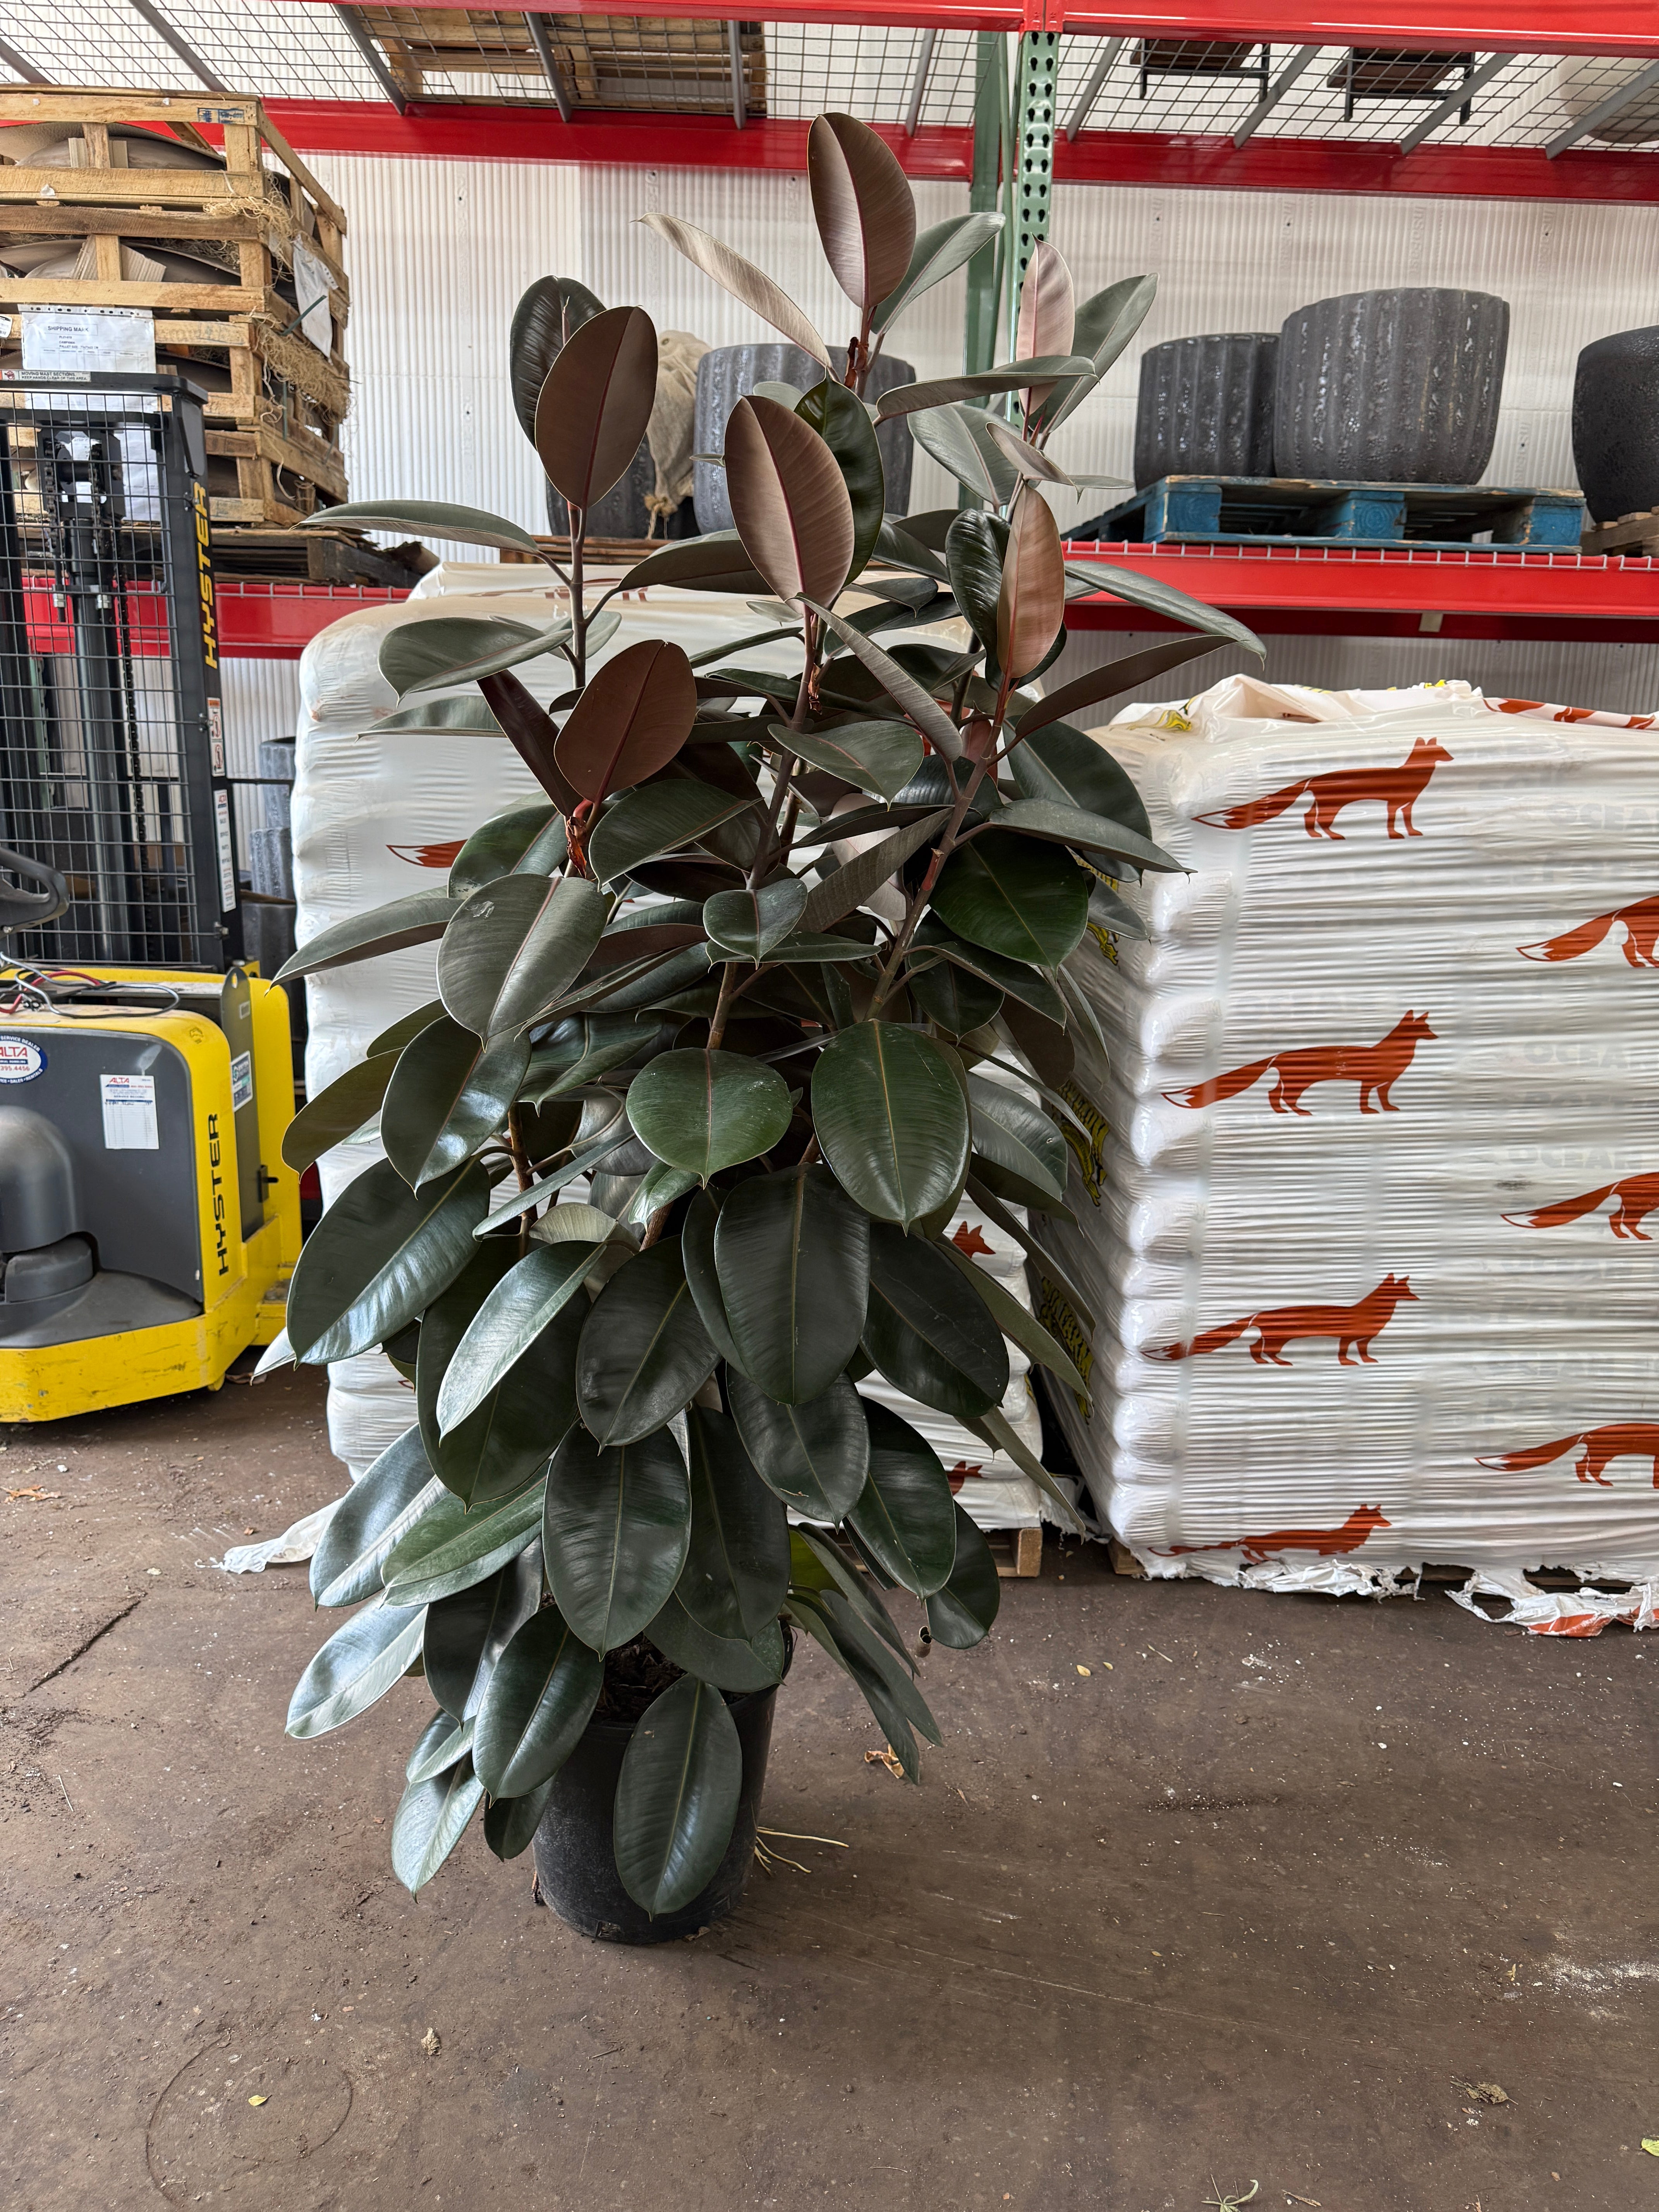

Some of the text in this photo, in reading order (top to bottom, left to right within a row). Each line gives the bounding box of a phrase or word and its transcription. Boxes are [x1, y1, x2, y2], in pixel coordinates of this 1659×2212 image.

[194, 481, 217, 669] HYSTER
[1548, 801, 1659, 831] OCEA
[22, 1038, 40, 1052] DEALER
[208, 1114, 229, 1276] HYSTER
